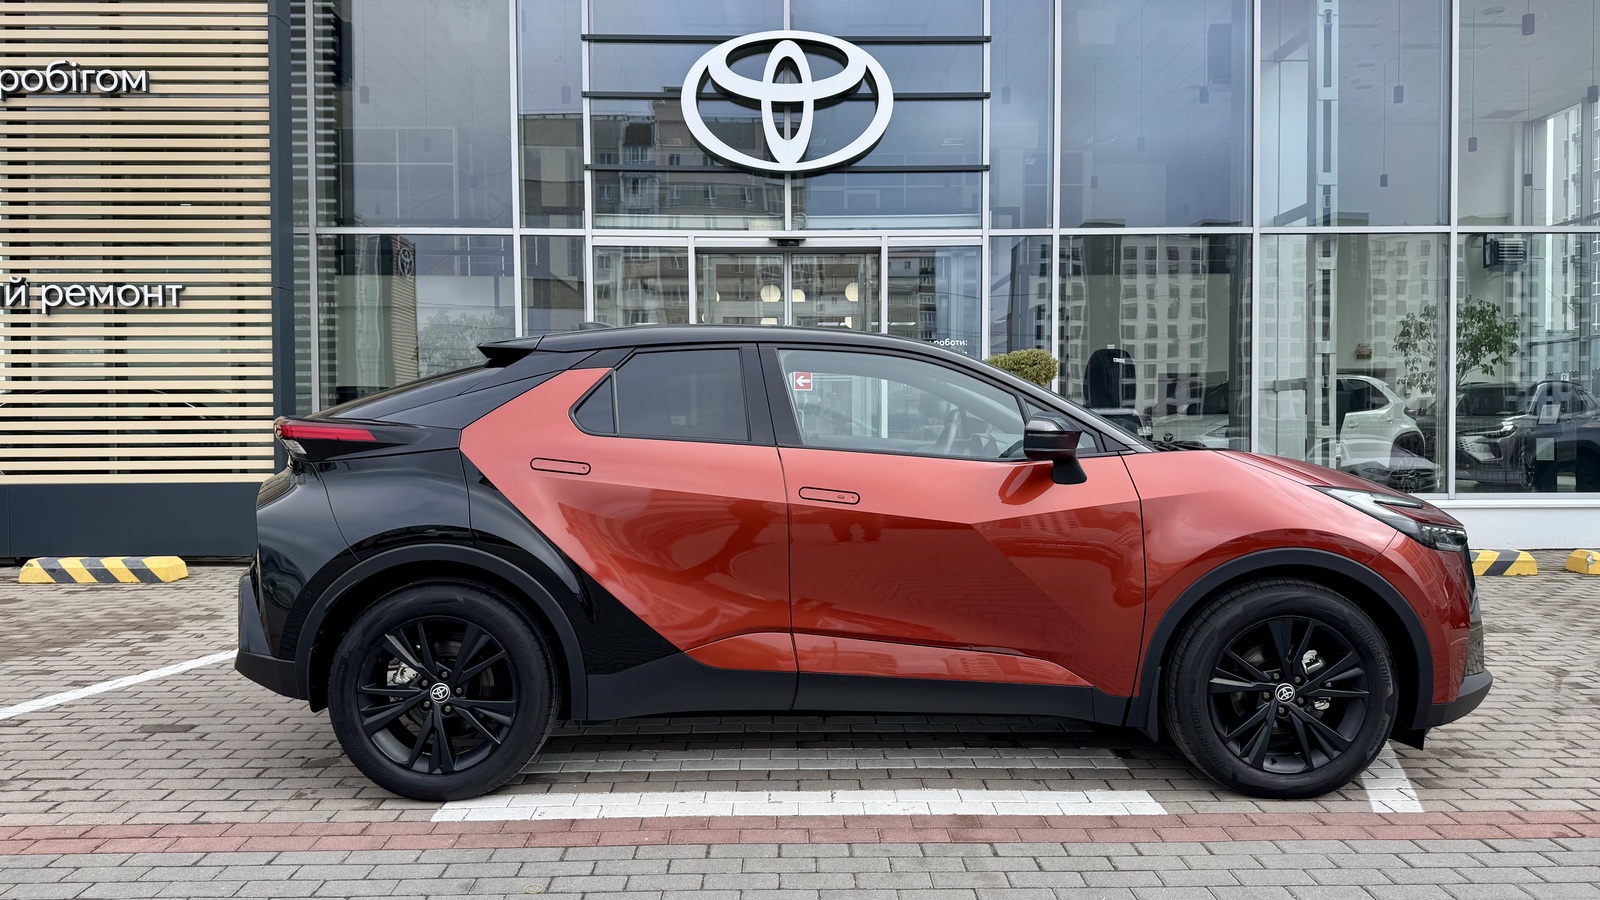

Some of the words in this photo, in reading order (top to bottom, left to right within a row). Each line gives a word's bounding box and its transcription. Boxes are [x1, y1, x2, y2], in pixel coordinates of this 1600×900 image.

[0, 60, 148, 100] робігом
[41, 283, 184, 315] ремонт
[1354, 622, 1391, 688] BRIDGESTONE
[1189, 704, 1227, 769] BRIDGESTONE
